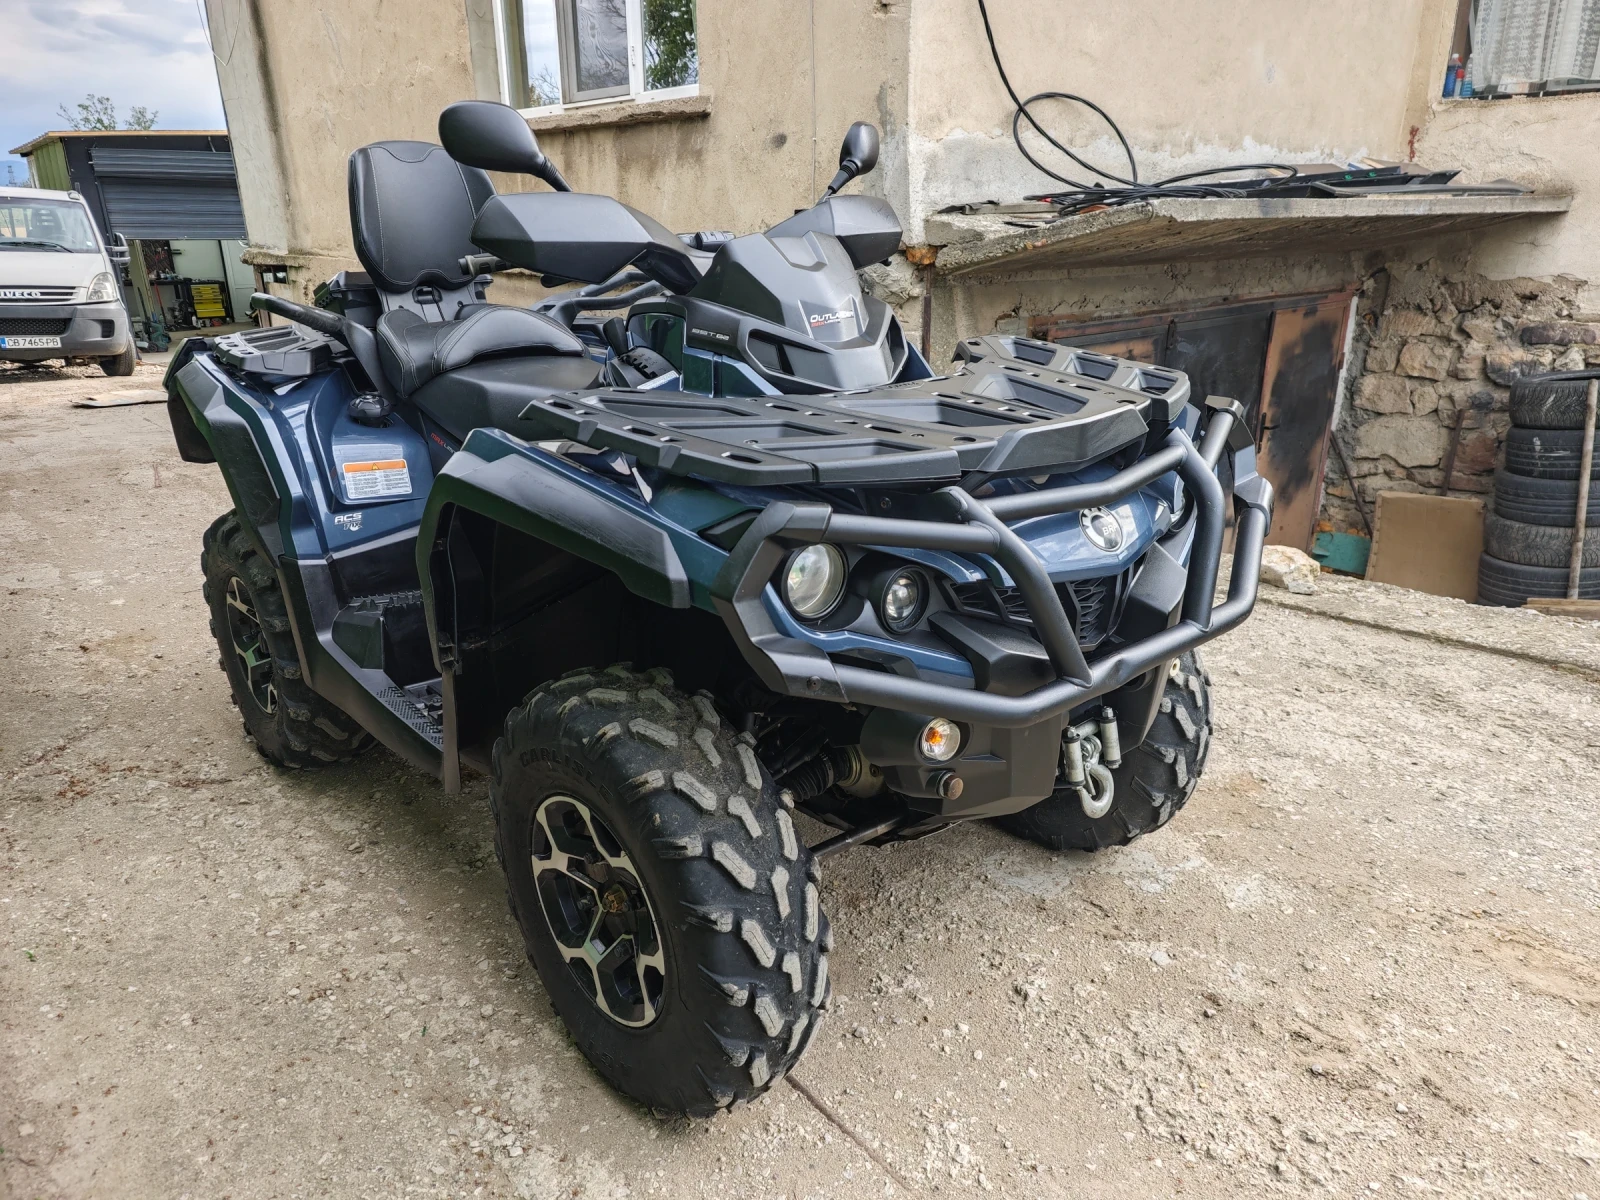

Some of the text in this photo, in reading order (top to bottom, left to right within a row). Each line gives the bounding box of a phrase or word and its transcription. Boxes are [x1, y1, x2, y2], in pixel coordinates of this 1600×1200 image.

[0, 290, 41, 299] IVECO
[7, 338, 20, 347] CB
[21, 338, 45, 347] 7465
[334, 512, 362, 524] ACS
